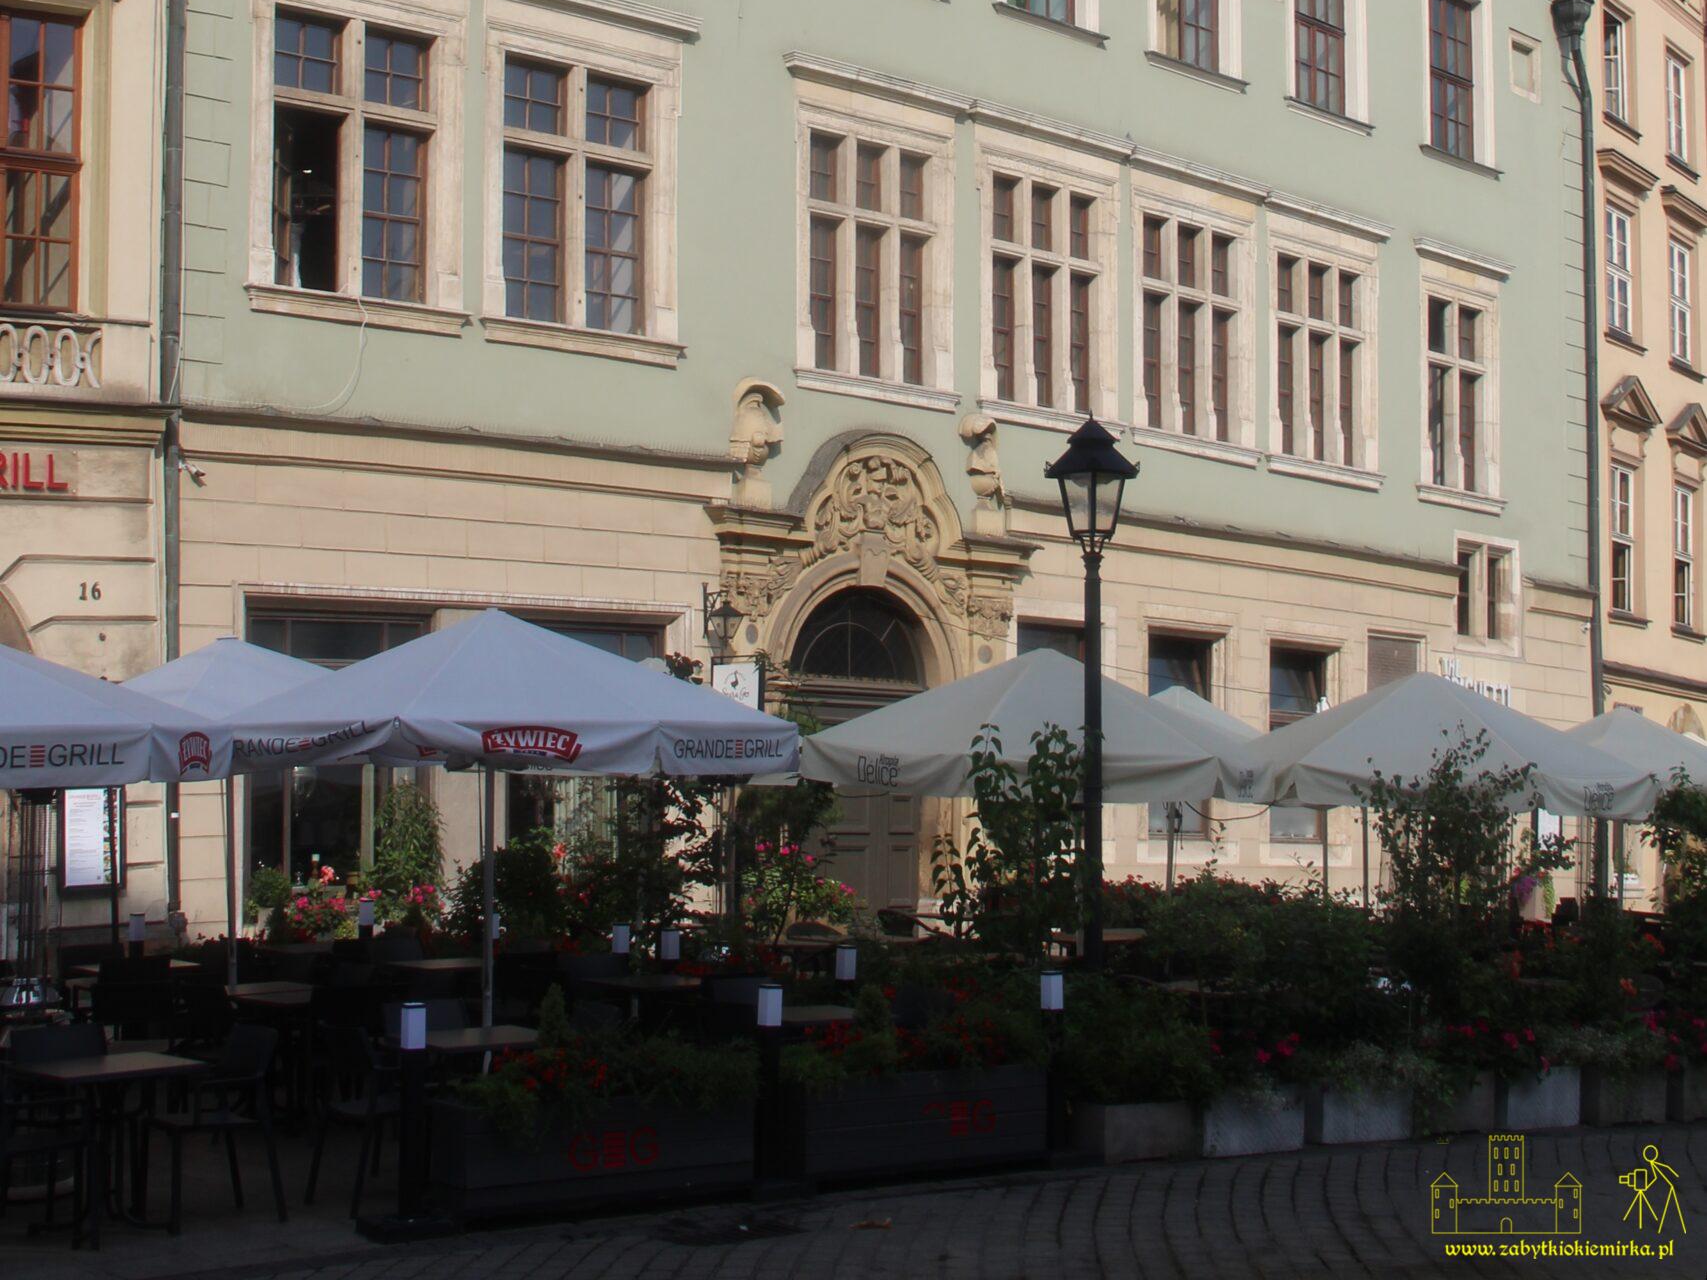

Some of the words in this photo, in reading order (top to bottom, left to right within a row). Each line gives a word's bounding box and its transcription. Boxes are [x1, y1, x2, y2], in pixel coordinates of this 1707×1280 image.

[79, 581, 102, 601] 16
[491, 729, 571, 751] ŻYWIEC
[673, 739, 734, 759] GRANDE
[744, 739, 783, 759] GRILL
[48, 743, 125, 767] GRILL
